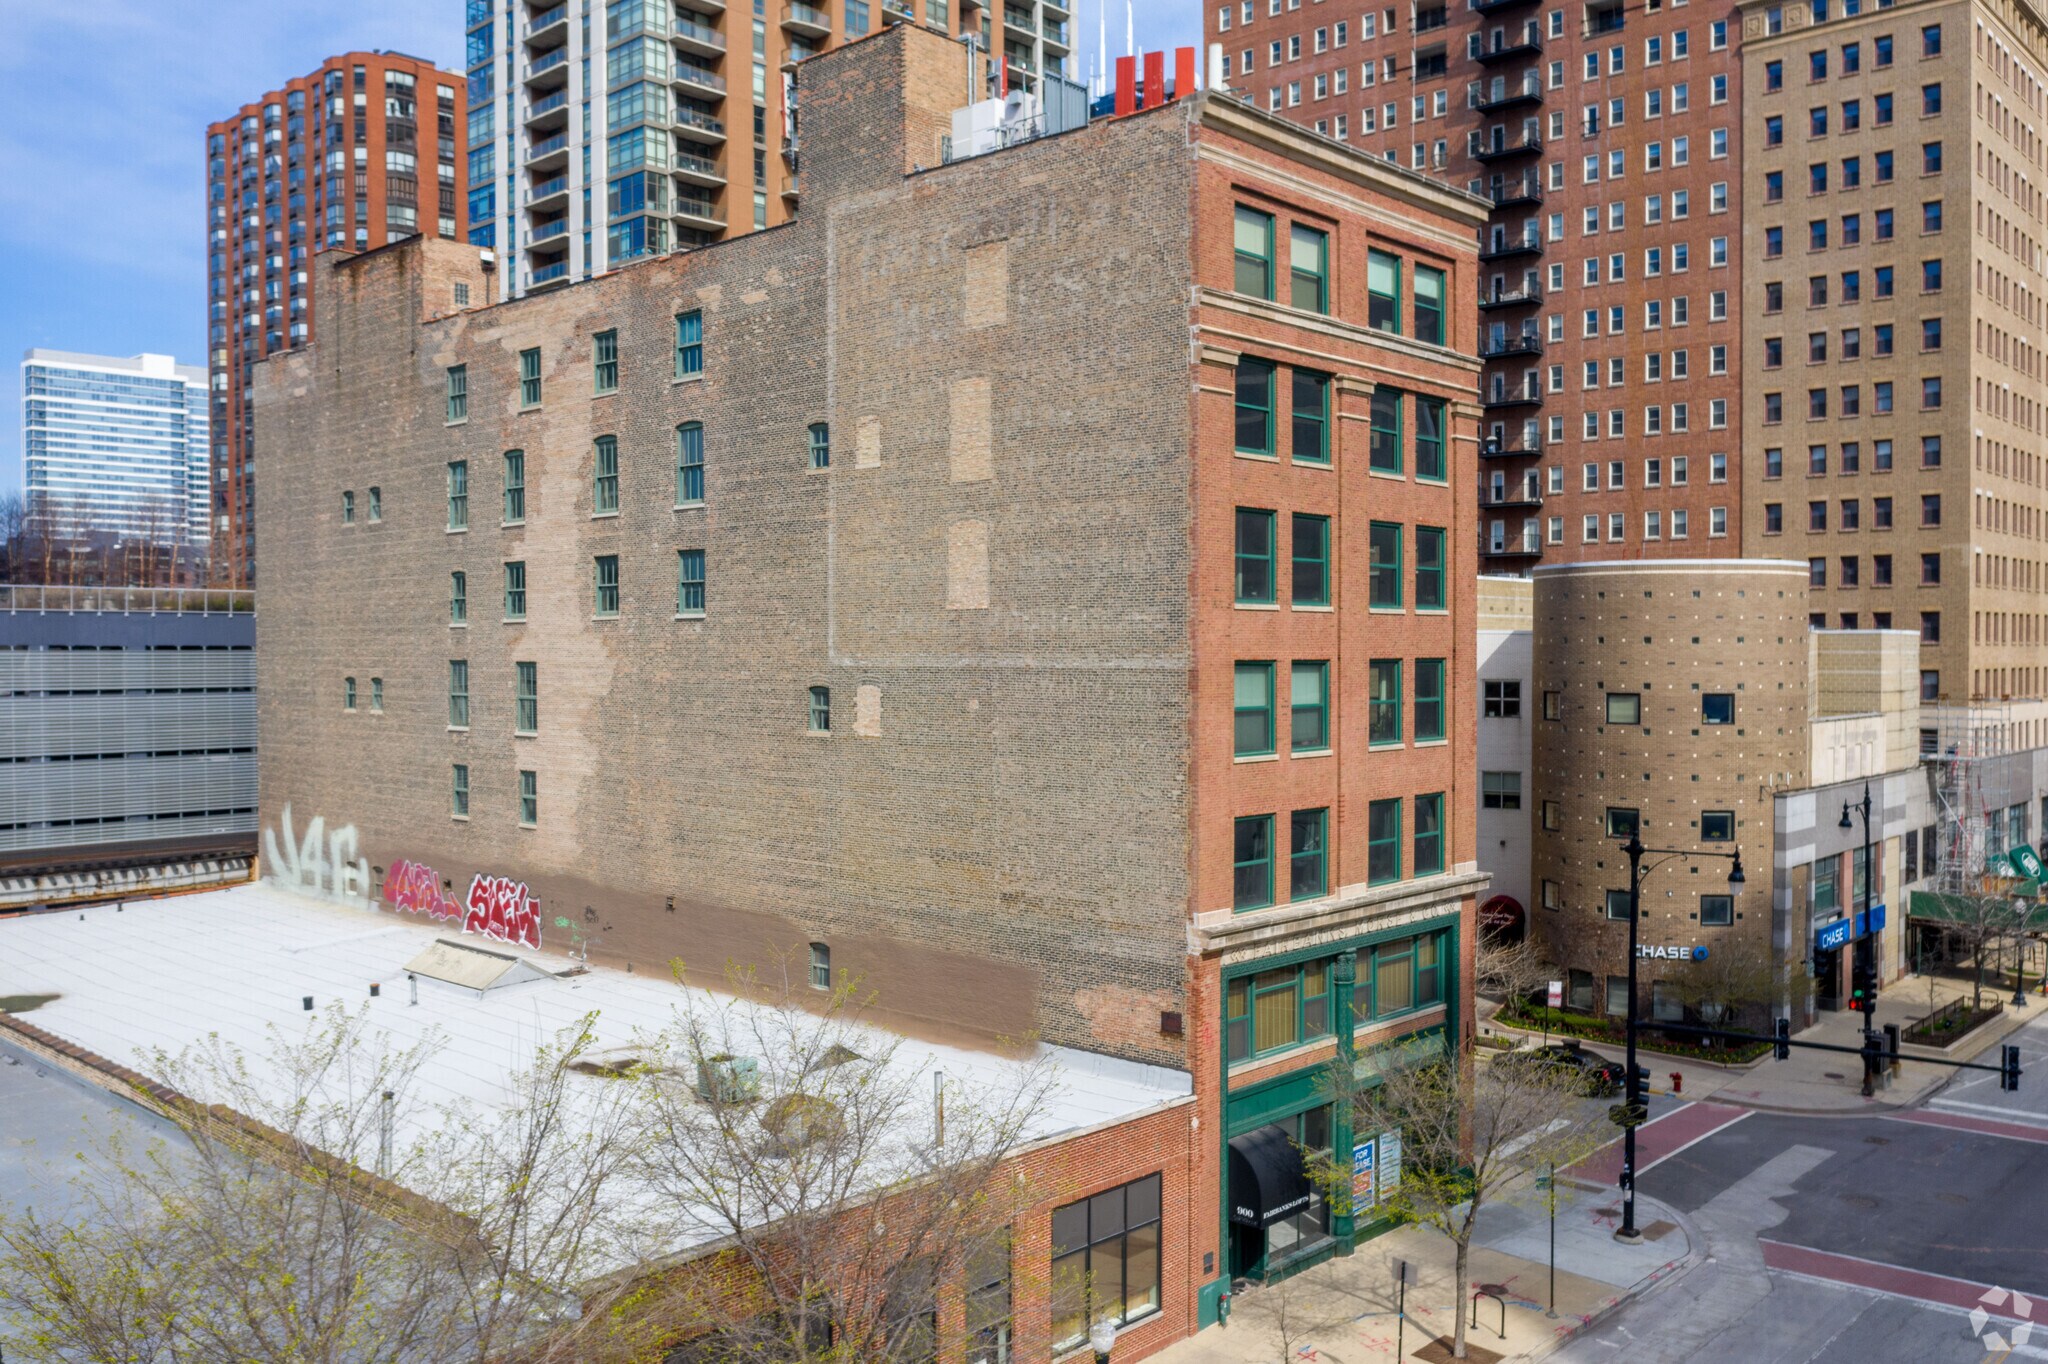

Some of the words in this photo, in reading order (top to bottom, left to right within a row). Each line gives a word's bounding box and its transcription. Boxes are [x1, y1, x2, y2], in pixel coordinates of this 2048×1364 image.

[1822, 927, 1844, 949] CHASE
[1355, 1148, 1368, 1161] FOR
[1236, 1205, 1254, 1219] 900
